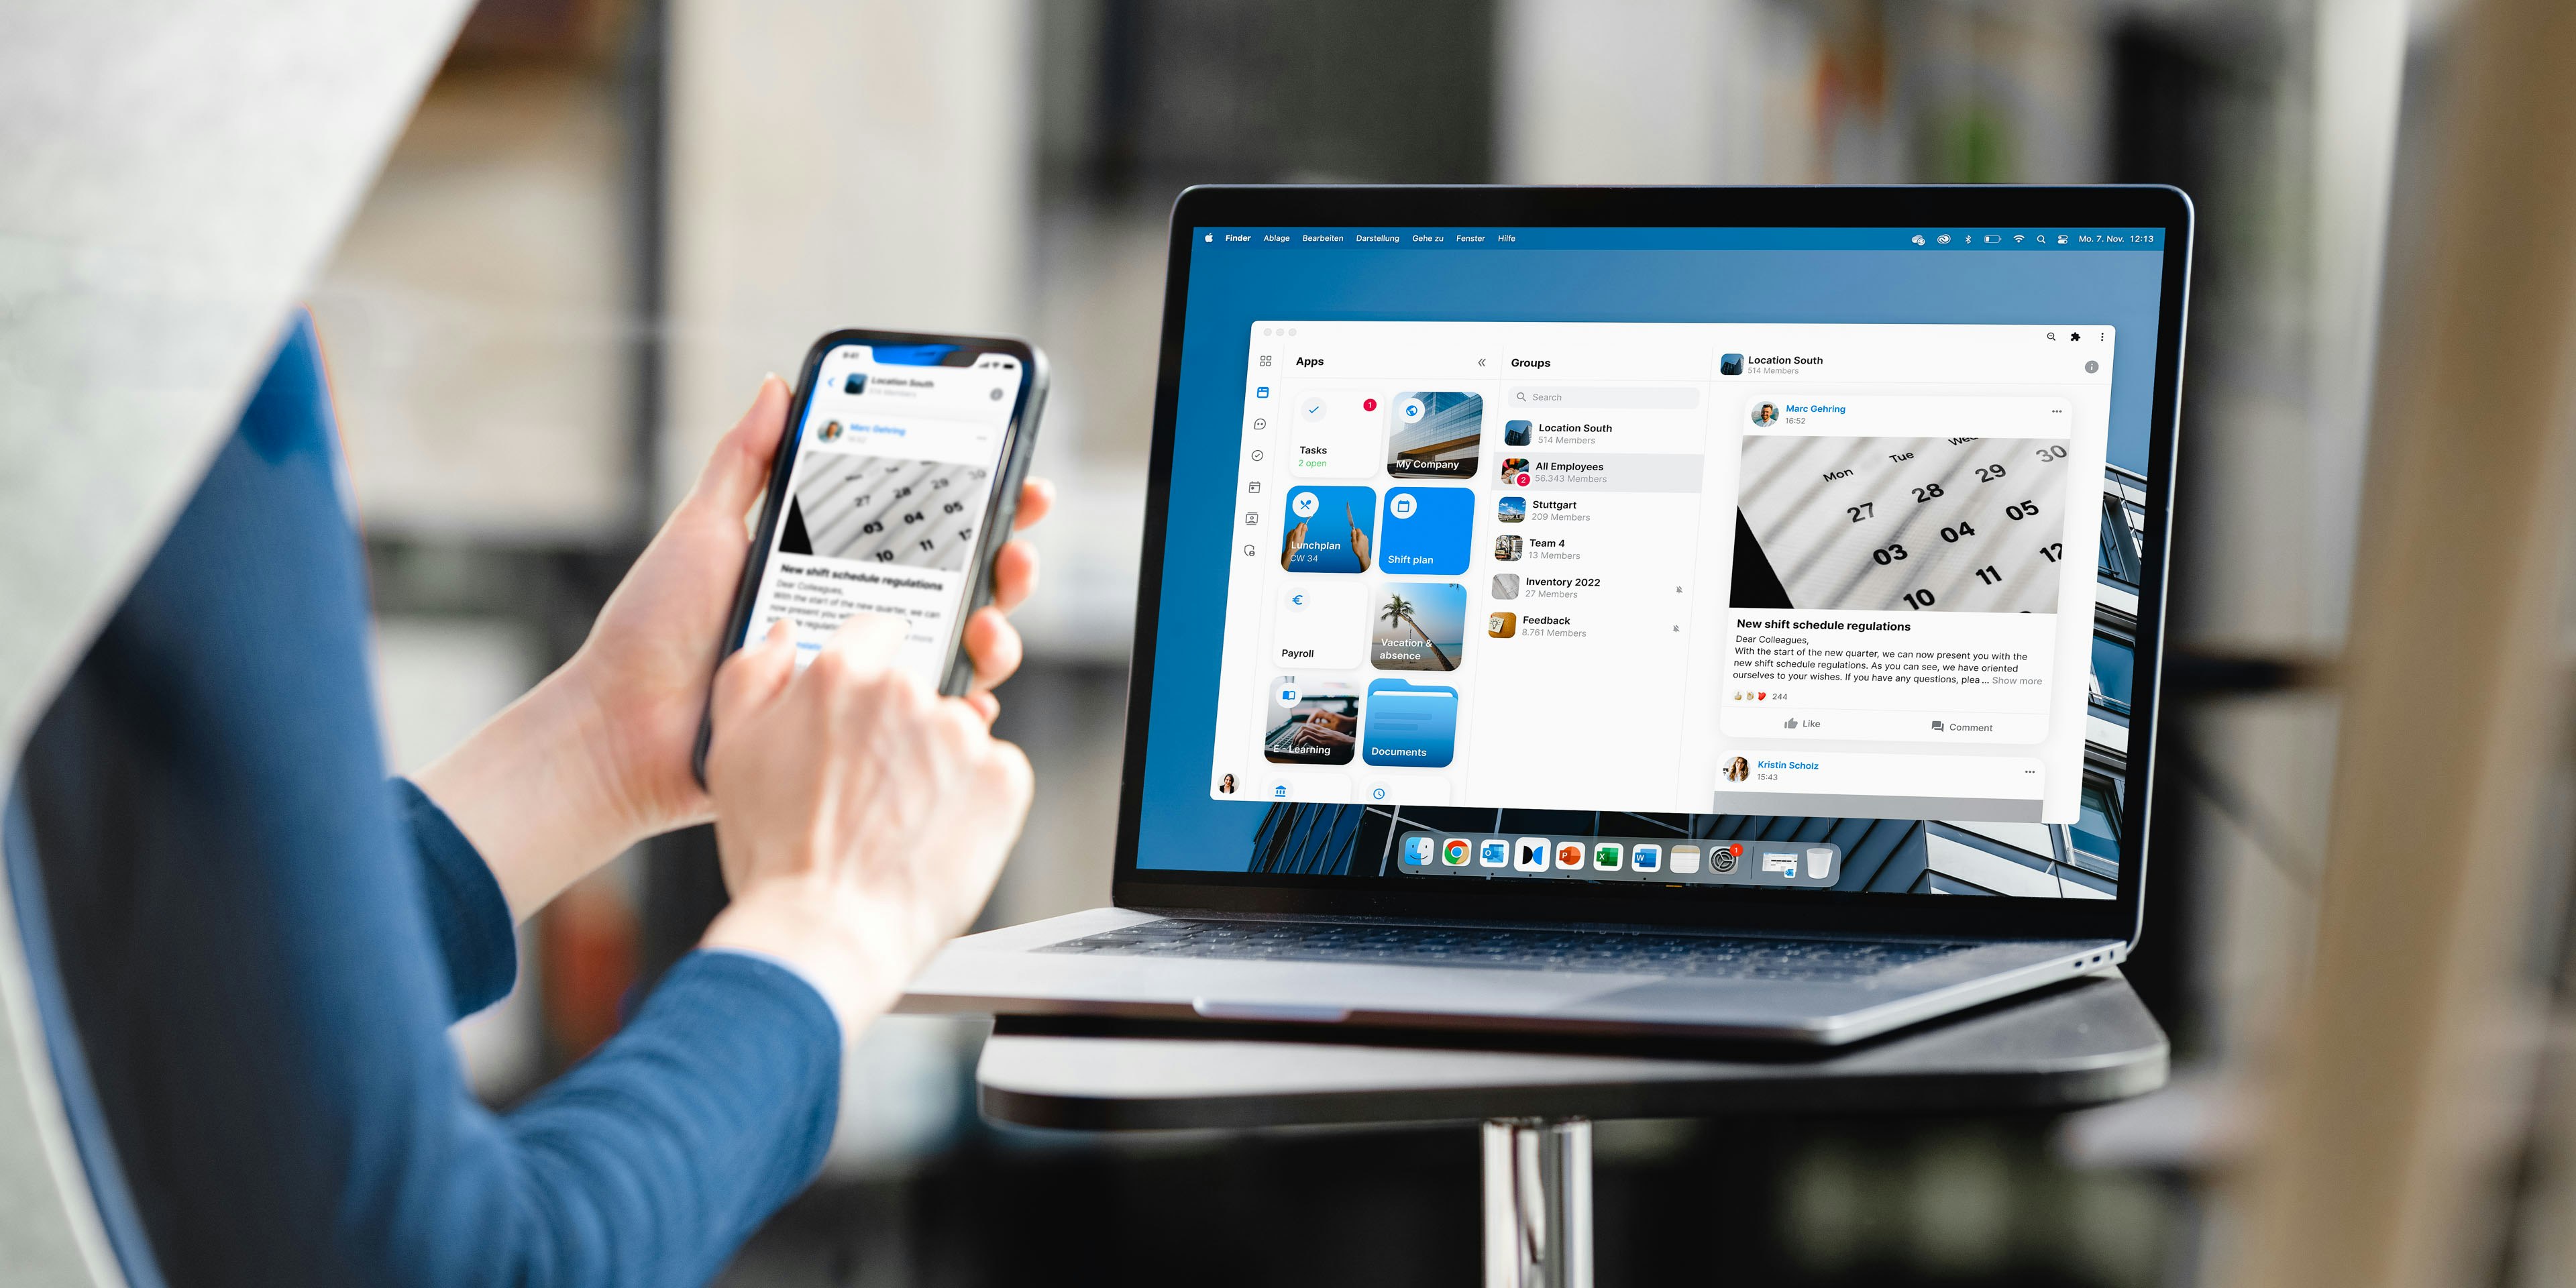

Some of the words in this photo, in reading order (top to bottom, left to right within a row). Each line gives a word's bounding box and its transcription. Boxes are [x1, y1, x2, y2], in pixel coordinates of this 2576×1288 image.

[1356, 235, 1399, 243] Darstellung
[1296, 357, 1324, 368] Apps
[1511, 359, 1550, 369] Groups
[1794, 356, 1823, 364] South
[871, 377, 908, 386] Location
[909, 378, 934, 388] South
[1811, 405, 1845, 414] Gehring
[1540, 424, 1580, 432] Location
[1300, 446, 1327, 454] Tasks
[1395, 459, 1412, 470] My
[1412, 459, 1459, 470] Company
[1551, 463, 1603, 472] Employees
[1823, 467, 1854, 482] Mon
[1889, 450, 1915, 464] Tue
[1847, 502, 1874, 523] 27
[1912, 484, 1944, 504] 28
[1975, 464, 2006, 483] 29
[2036, 445, 2067, 462] 30
[1533, 500, 1576, 511] Stuttgart
[863, 521, 884, 535] 03
[904, 511, 924, 525] 04
[943, 500, 963, 515] 05
[1871, 542, 1908, 567] 03
[1941, 521, 1975, 543] 04
[2006, 500, 2039, 521] 05
[876, 549, 894, 563] 10
[919, 539, 934, 551] 11
[1290, 540, 1340, 552] Lunchplan
[1289, 554, 1305, 563] CW
[1388, 555, 1411, 564] Shift
[1413, 556, 1433, 566] plan
[780, 564, 804, 574] New
[806, 567, 830, 578] shift
[832, 572, 880, 583] schedule
[882, 578, 943, 592] regulations
[1527, 578, 1572, 588] Inventory
[1575, 578, 1600, 586] 2022
[1903, 589, 1935, 610] 10
[1976, 566, 2002, 585] 11
[1523, 616, 1570, 625] Feedback
[1737, 619, 1762, 628] New
[1765, 620, 1790, 629] shift
[1793, 621, 1844, 629] schedule
[1847, 622, 1911, 632] regulations
[1381, 637, 1424, 649] Vacation
[1426, 639, 1432, 647] &
[1759, 636, 1809, 645] Colleagues,
[1282, 649, 1313, 659] Payroll
[1380, 651, 1420, 661] absence
[1818, 661, 1868, 670] regulations.
[1854, 674, 1870, 682] you
[1914, 676, 1958, 684] questions,
[1962, 676, 1980, 684] plea
[1273, 745, 1279, 753] E
[1288, 744, 1330, 755] Learning
[1372, 747, 1426, 756] Documents
